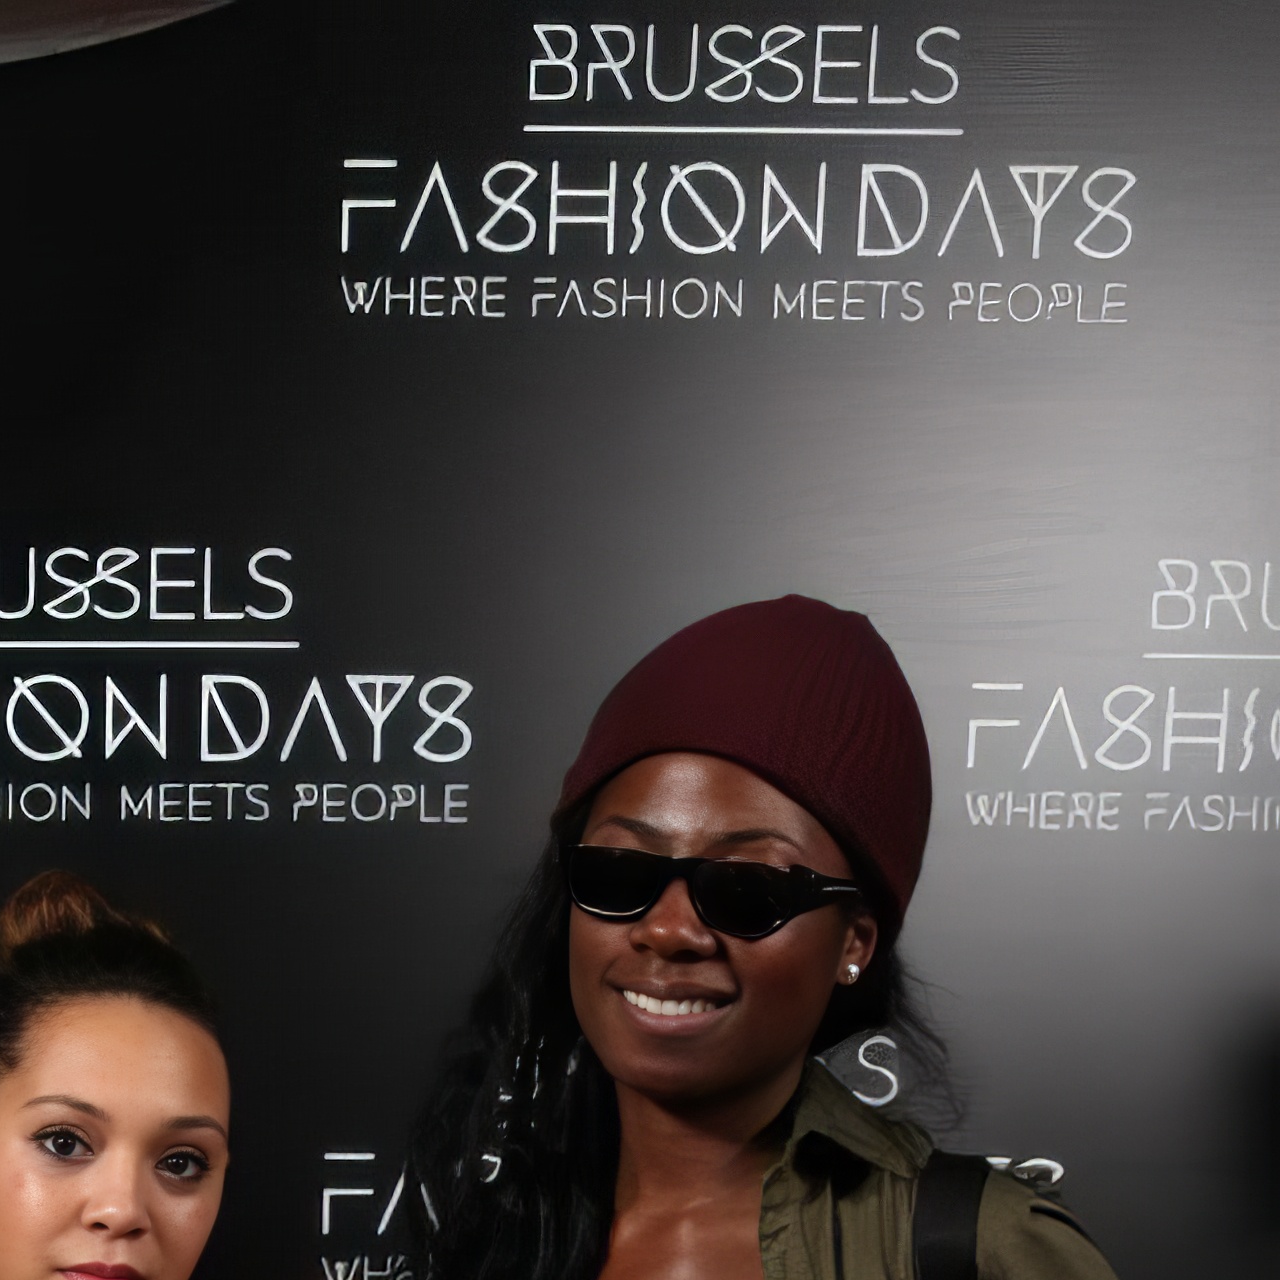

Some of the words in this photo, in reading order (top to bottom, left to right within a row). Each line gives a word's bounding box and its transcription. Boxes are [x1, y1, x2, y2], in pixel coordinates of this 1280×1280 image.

[528, 23, 960, 105] BRUSSELS
[341, 158, 827, 256] FASHION
[856, 163, 1137, 260] DAYS
[340, 275, 508, 318] WHERE
[531, 276, 743, 319] FASHION
[773, 279, 925, 322] MEETS
[948, 281, 1128, 323] PEOPLE
[200, 674, 474, 763] DAYS
[966, 682, 1280, 774] FASHI
[120, 782, 270, 822] MEETS
[292, 783, 469, 824] PEOPLE
[965, 790, 1123, 831] WHERE
[1144, 792, 1280, 832] FASHI
